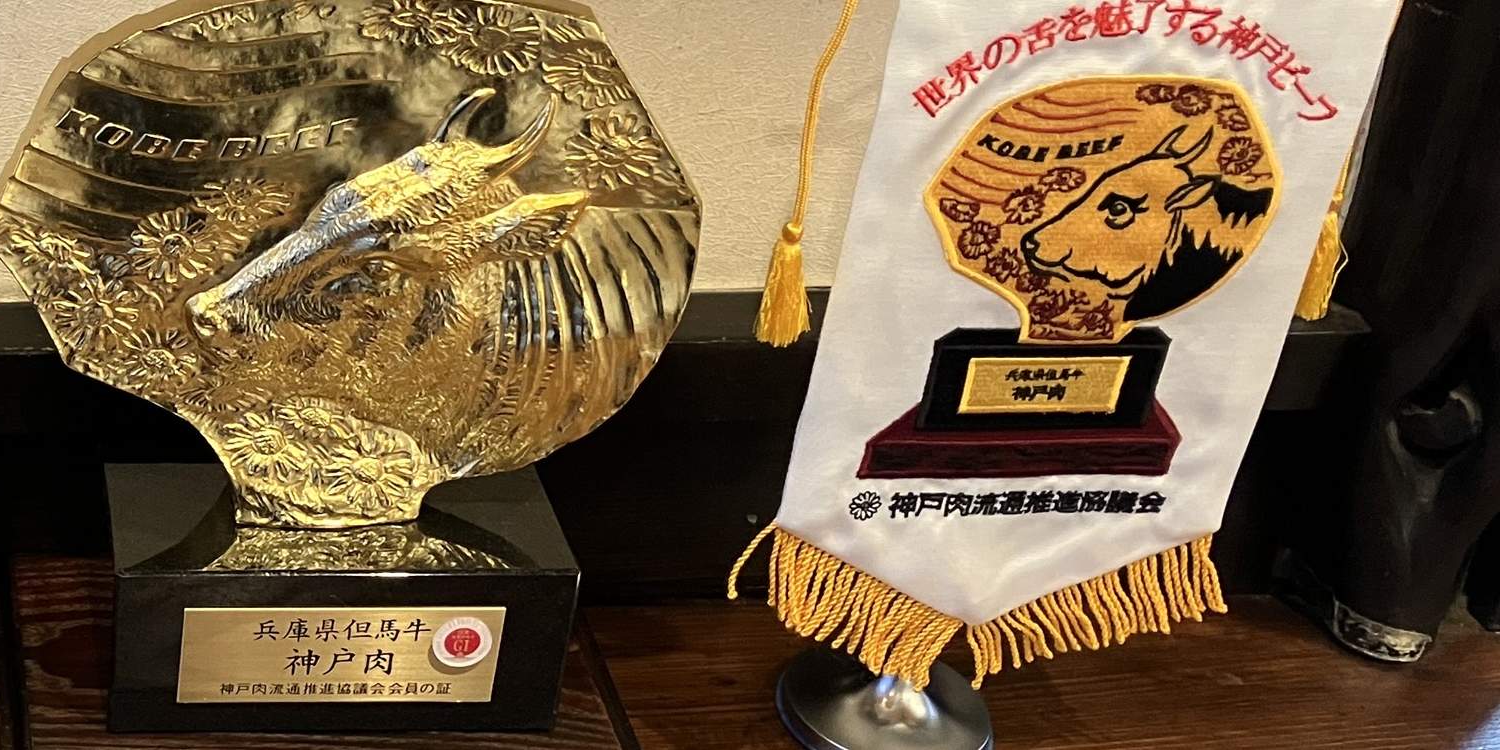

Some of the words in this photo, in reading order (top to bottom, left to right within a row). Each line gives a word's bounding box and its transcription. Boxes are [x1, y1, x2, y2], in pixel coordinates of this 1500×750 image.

[912, 0, 1338, 121] 世界の舌を魅了する神戸ビーフ
[55, 108, 208, 161] KOBE
[219, 118, 358, 159] BEEF
[977, 134, 1050, 162] KOBE
[1055, 134, 1124, 159] BEEF
[1011, 383, 1066, 401] 神戸肉
[889, 491, 1166, 518] 神戸肉流通推進協議会
[253, 618, 432, 643] 兵庫県但馬牛
[283, 648, 394, 676] 神戸肉
[220, 682, 452, 696] 神戸肉流通推進協議会会員の証
